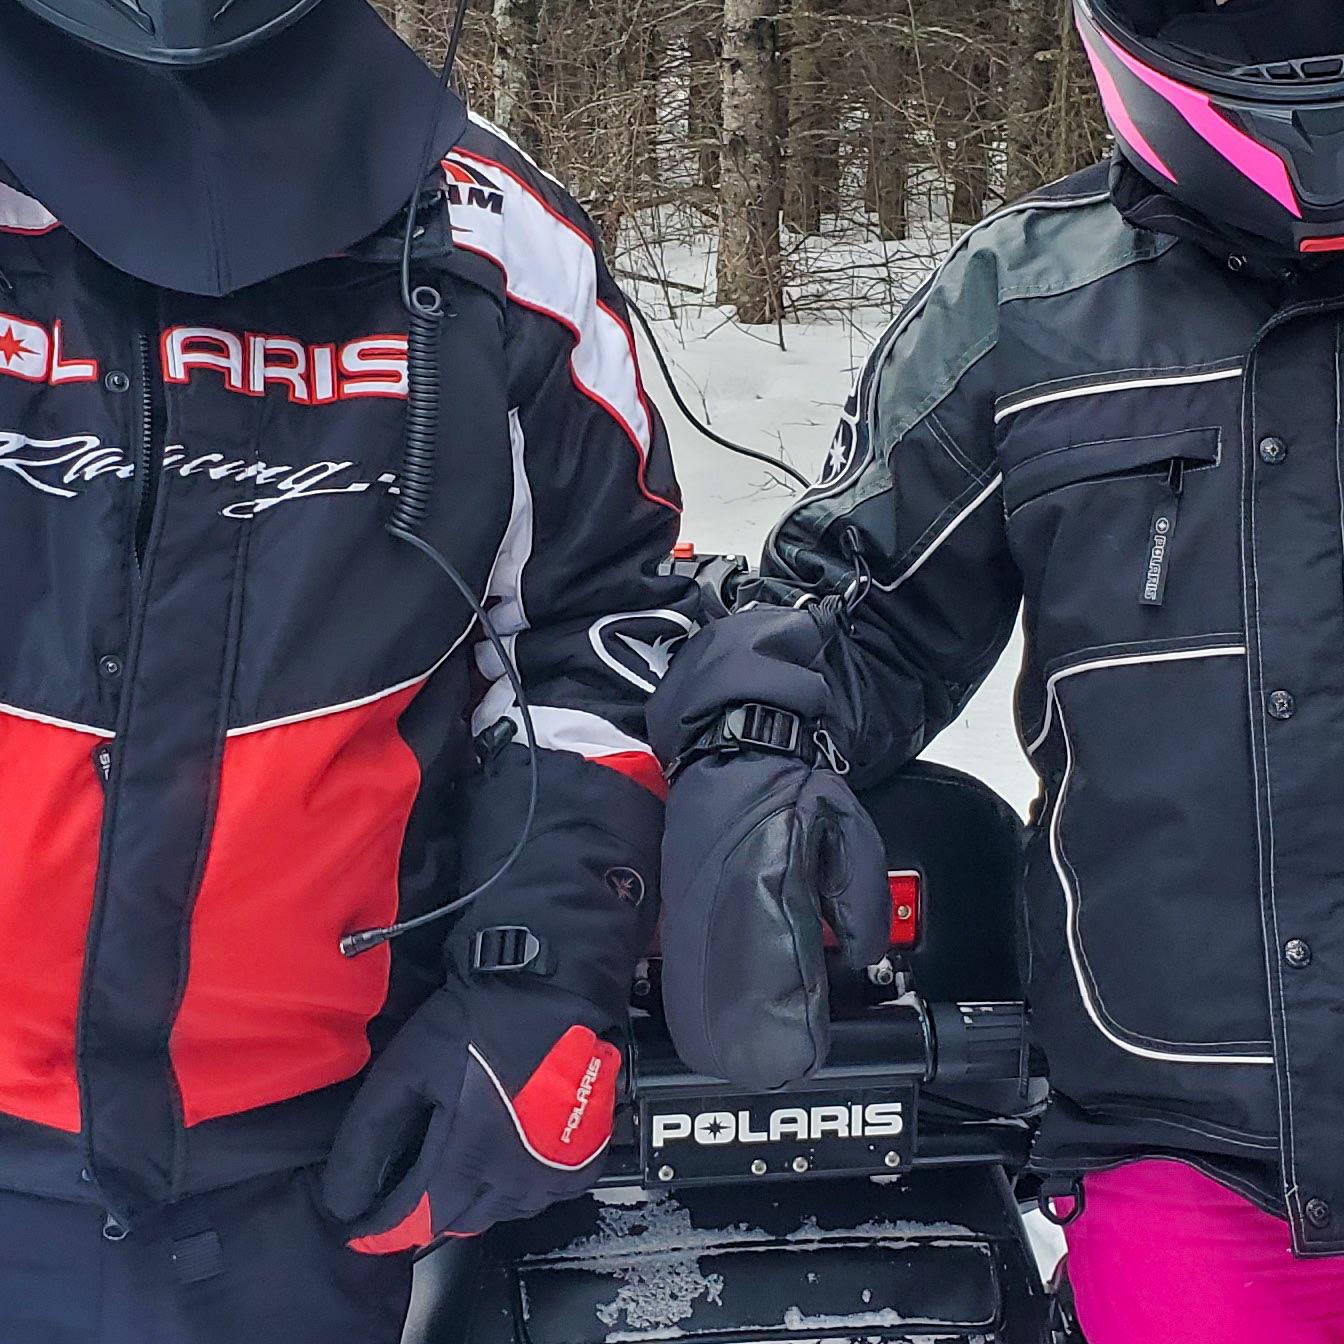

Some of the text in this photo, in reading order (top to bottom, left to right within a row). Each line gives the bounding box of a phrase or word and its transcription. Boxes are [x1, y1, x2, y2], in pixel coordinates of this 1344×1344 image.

[1144, 535, 1167, 600] POLARIS
[560, 1056, 602, 1144] POLARIS
[652, 1102, 904, 1148] POLARIS
